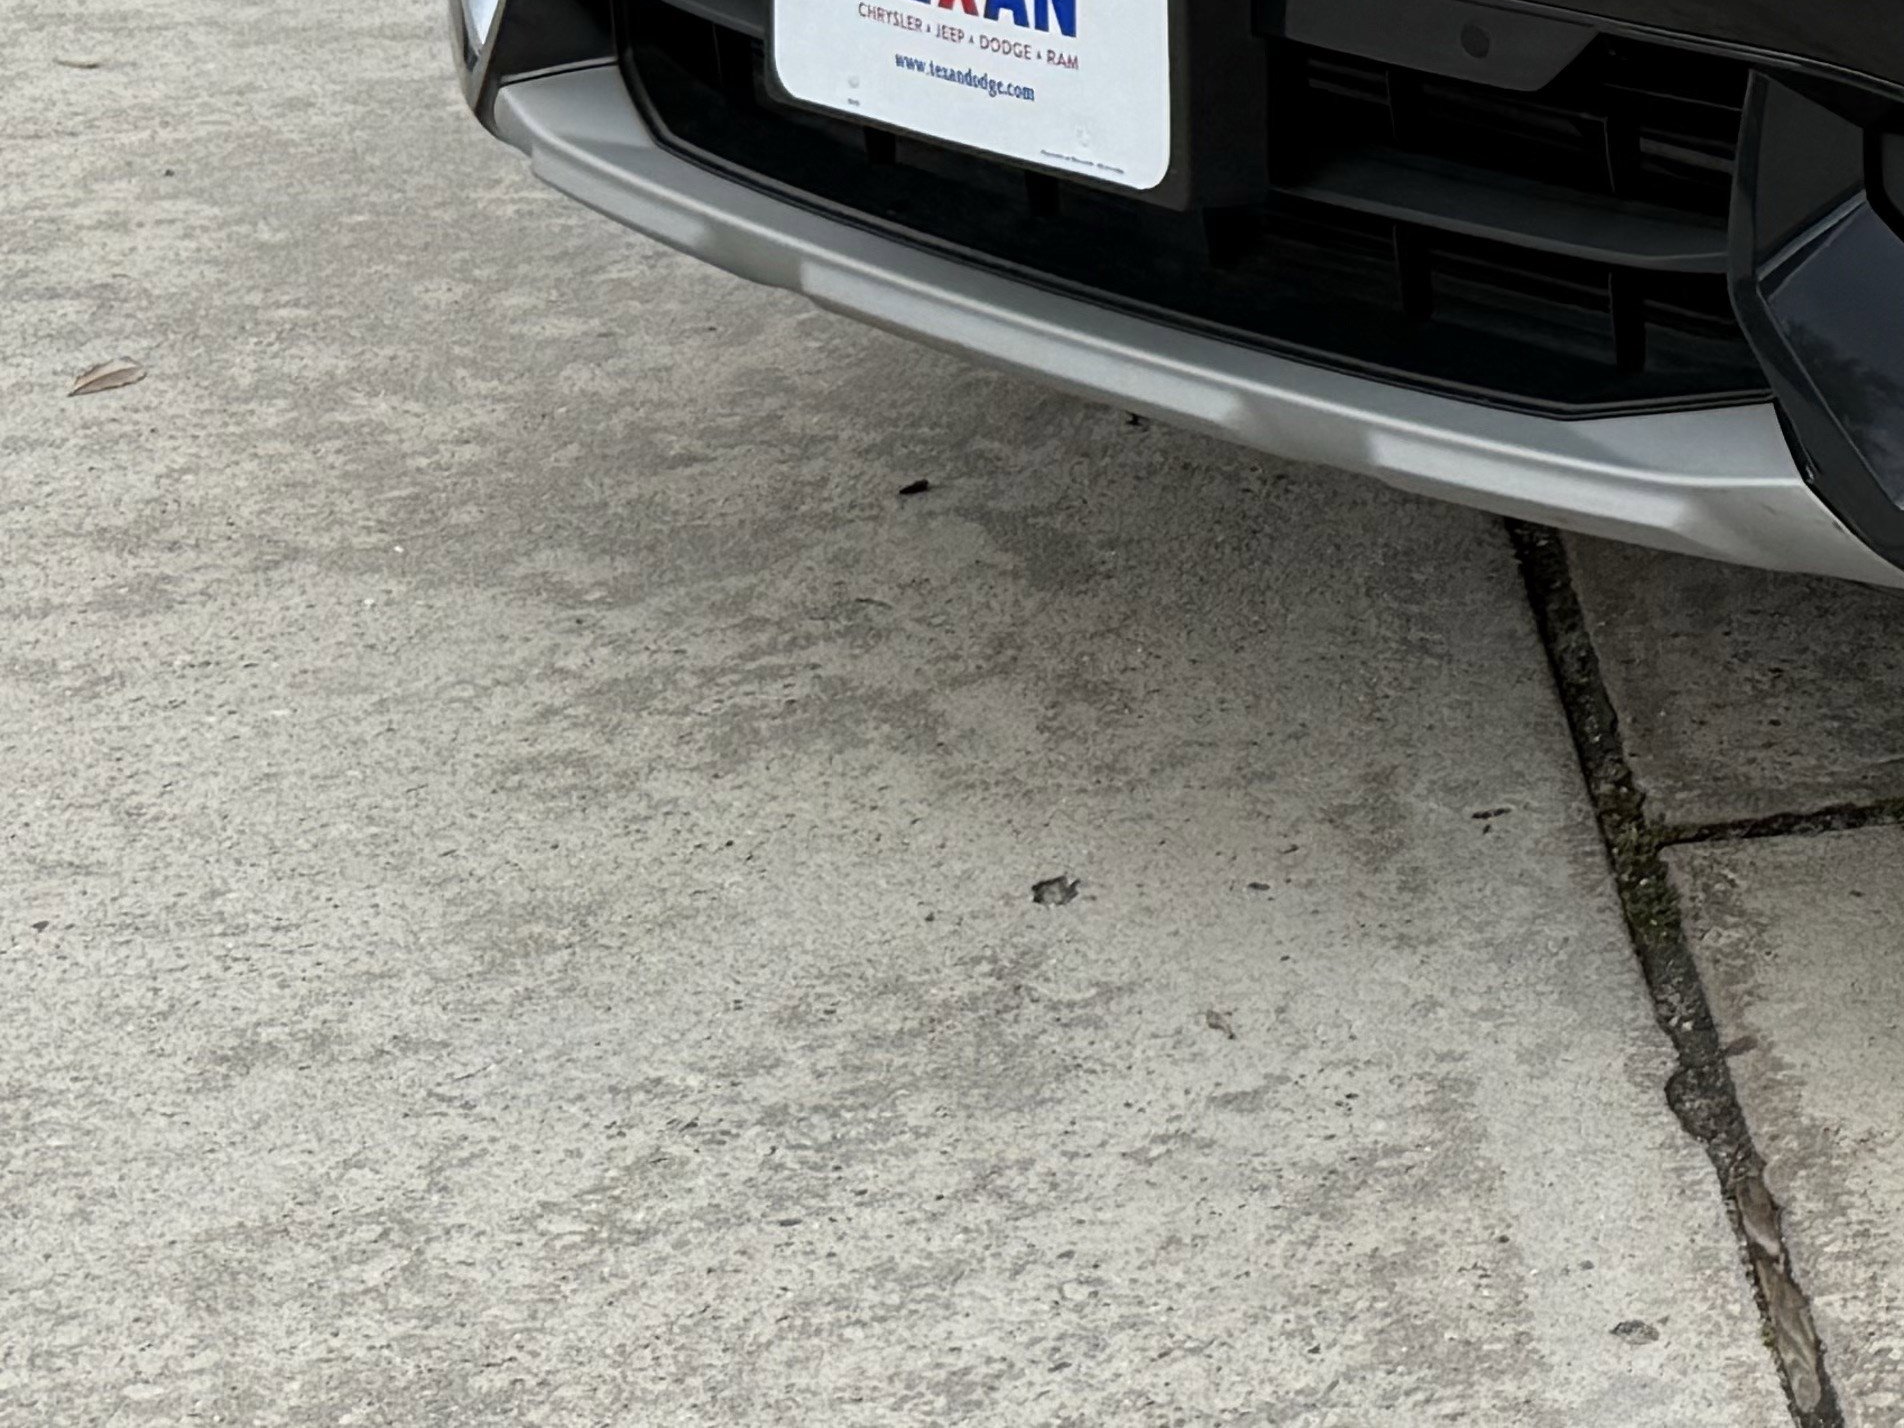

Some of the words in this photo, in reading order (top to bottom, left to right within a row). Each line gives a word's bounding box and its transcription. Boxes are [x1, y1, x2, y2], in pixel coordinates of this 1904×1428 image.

[858, 1, 923, 33] CHRYSLER
[936, 23, 965, 44] JEEP
[979, 34, 1032, 61] DODGE
[1046, 49, 1080, 70] RAM
[895, 52, 1036, 101] www.texandodge.com
